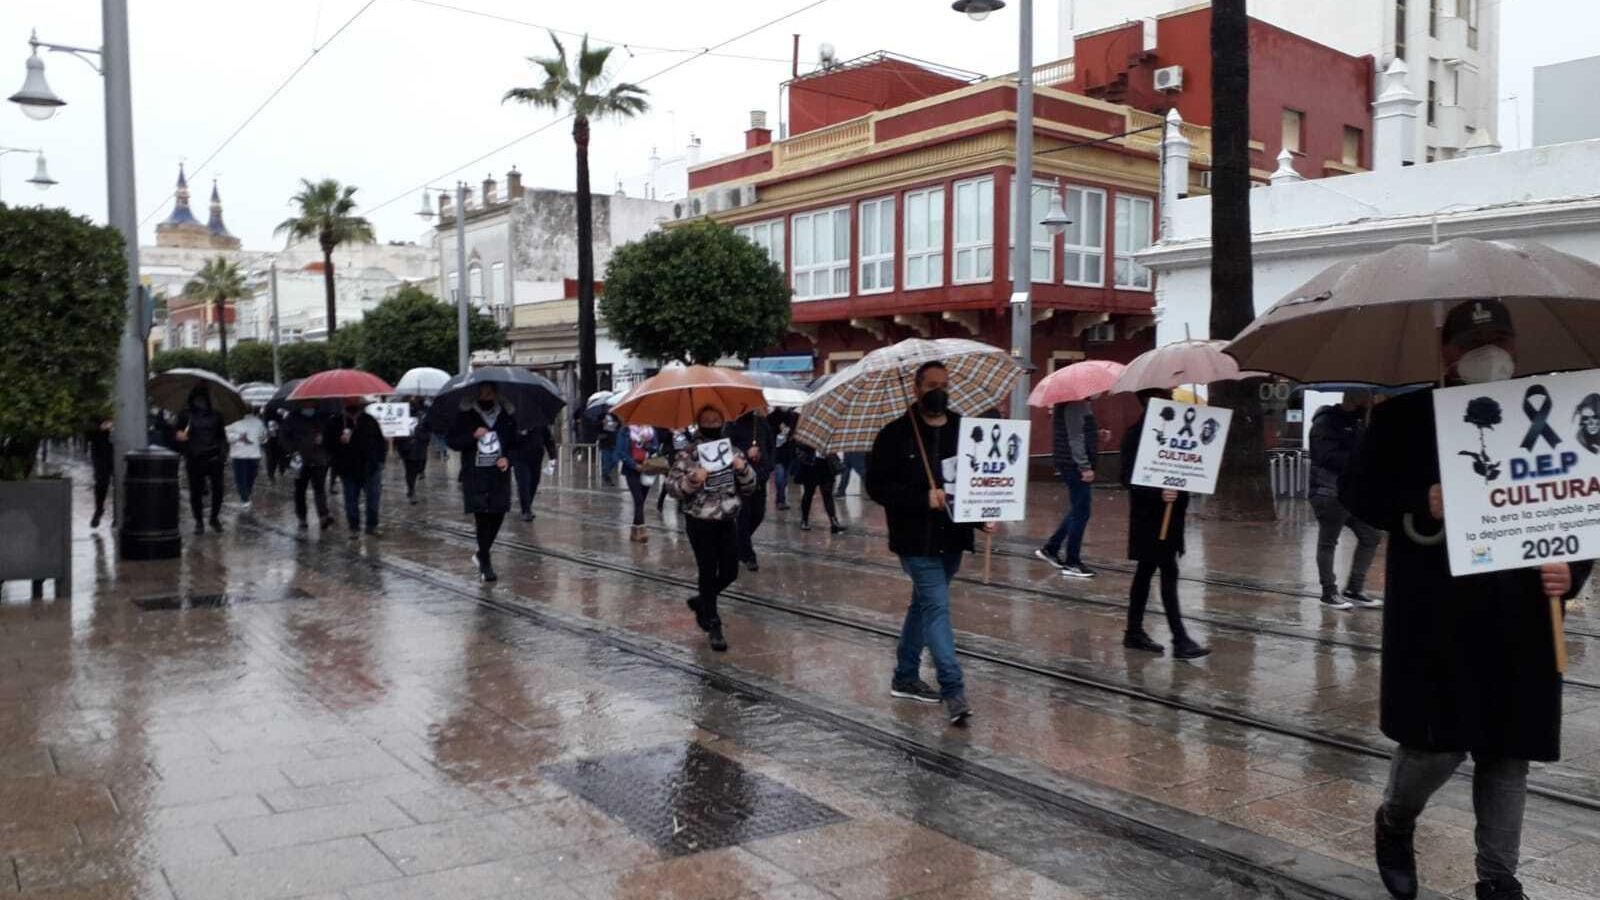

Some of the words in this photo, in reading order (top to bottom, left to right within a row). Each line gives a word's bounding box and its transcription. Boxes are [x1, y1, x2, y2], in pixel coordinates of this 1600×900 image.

[1170, 438, 1198, 450] D.E.P
[1159, 450, 1202, 463] CULTURA
[982, 461, 1006, 473] D.E.P
[1509, 451, 1578, 480] D.E.P
[970, 477, 1015, 487] COMERCIO
[1163, 476, 1186, 487] 2020
[1490, 477, 1600, 507] CULTURA
[1481, 515, 1497, 525] No
[1500, 512, 1519, 522] era
[1522, 508, 1533, 519] la
[1536, 504, 1584, 519] culpable
[1466, 532, 1477, 541] la
[1479, 527, 1522, 541] dejaron
[1526, 522, 1556, 533] morir
[1522, 535, 1579, 560] 2020
